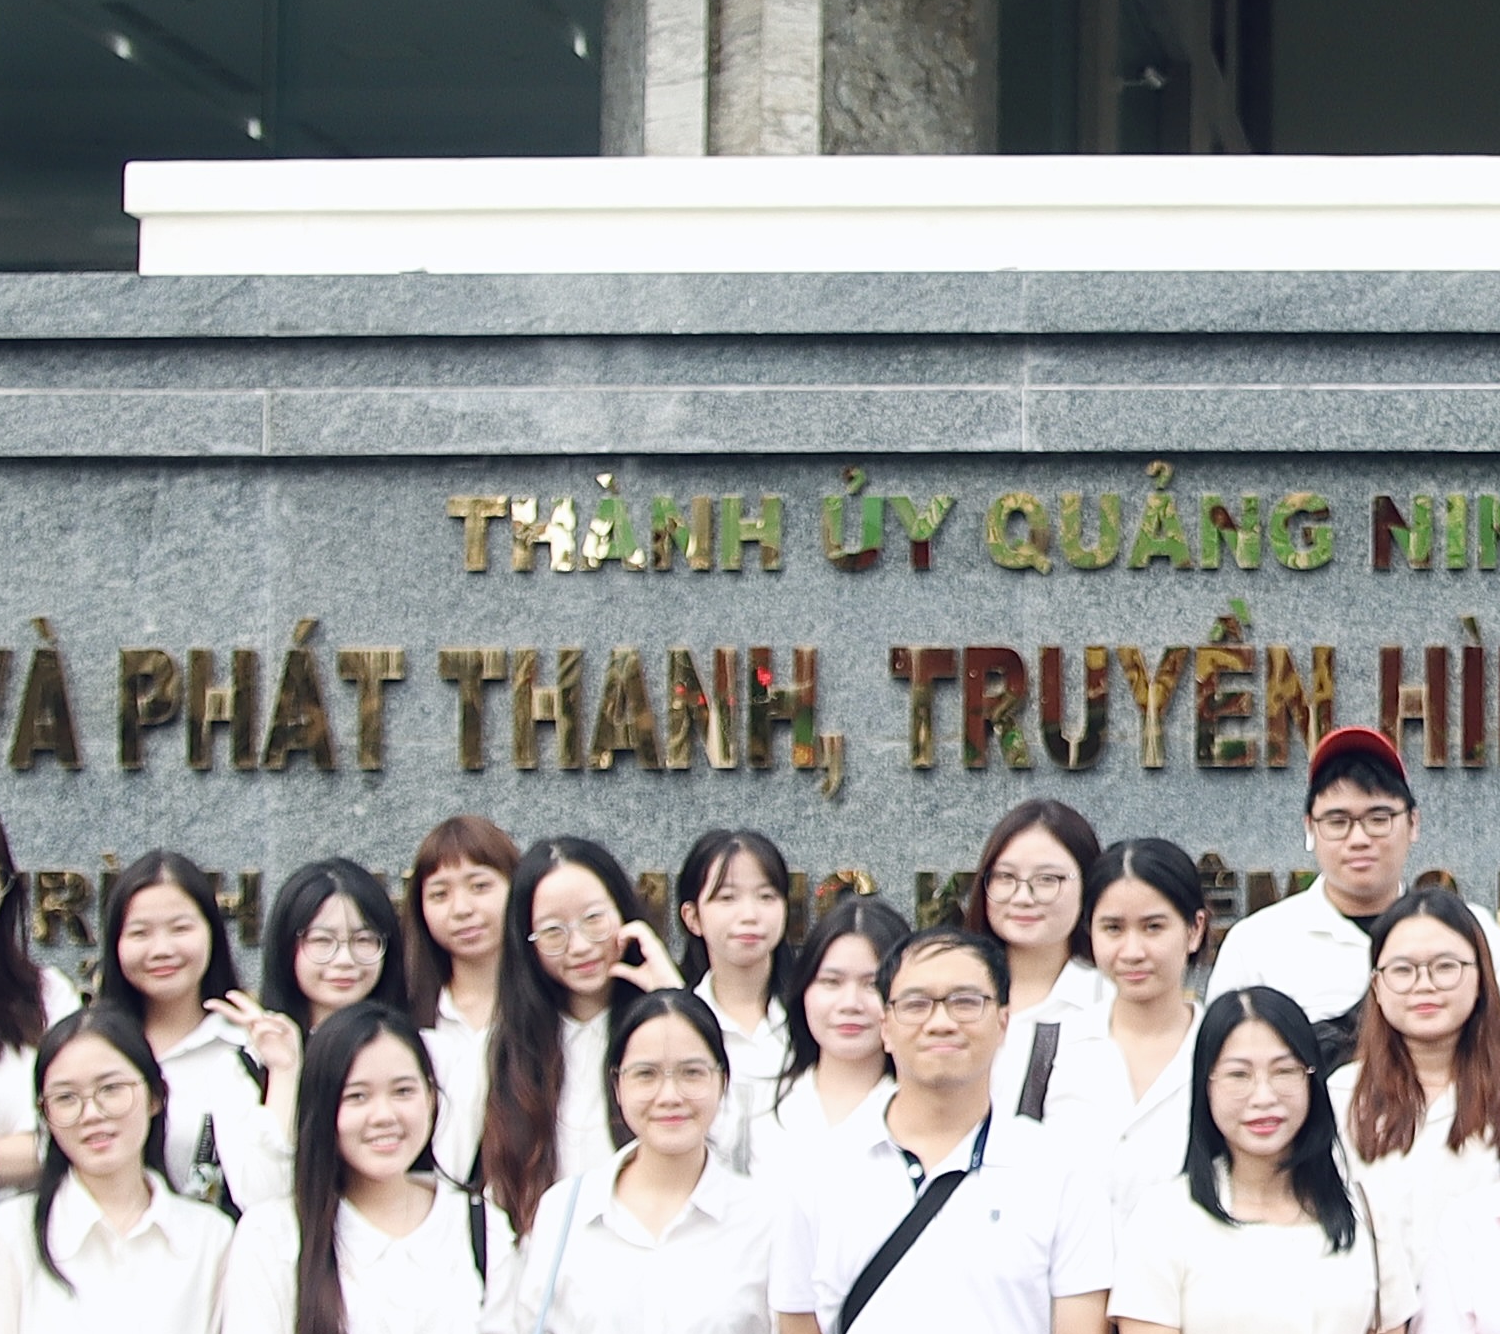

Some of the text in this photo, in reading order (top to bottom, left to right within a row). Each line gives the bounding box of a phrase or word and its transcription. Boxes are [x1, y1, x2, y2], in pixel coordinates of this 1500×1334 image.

[446, 471, 785, 573] THÀNH
[820, 468, 957, 573] ỦY
[985, 462, 1334, 573] QUẢNG
[116, 619, 406, 771] PHÁT
[437, 645, 845, 797] THANH,
[888, 599, 1337, 770] TRUYỀN
